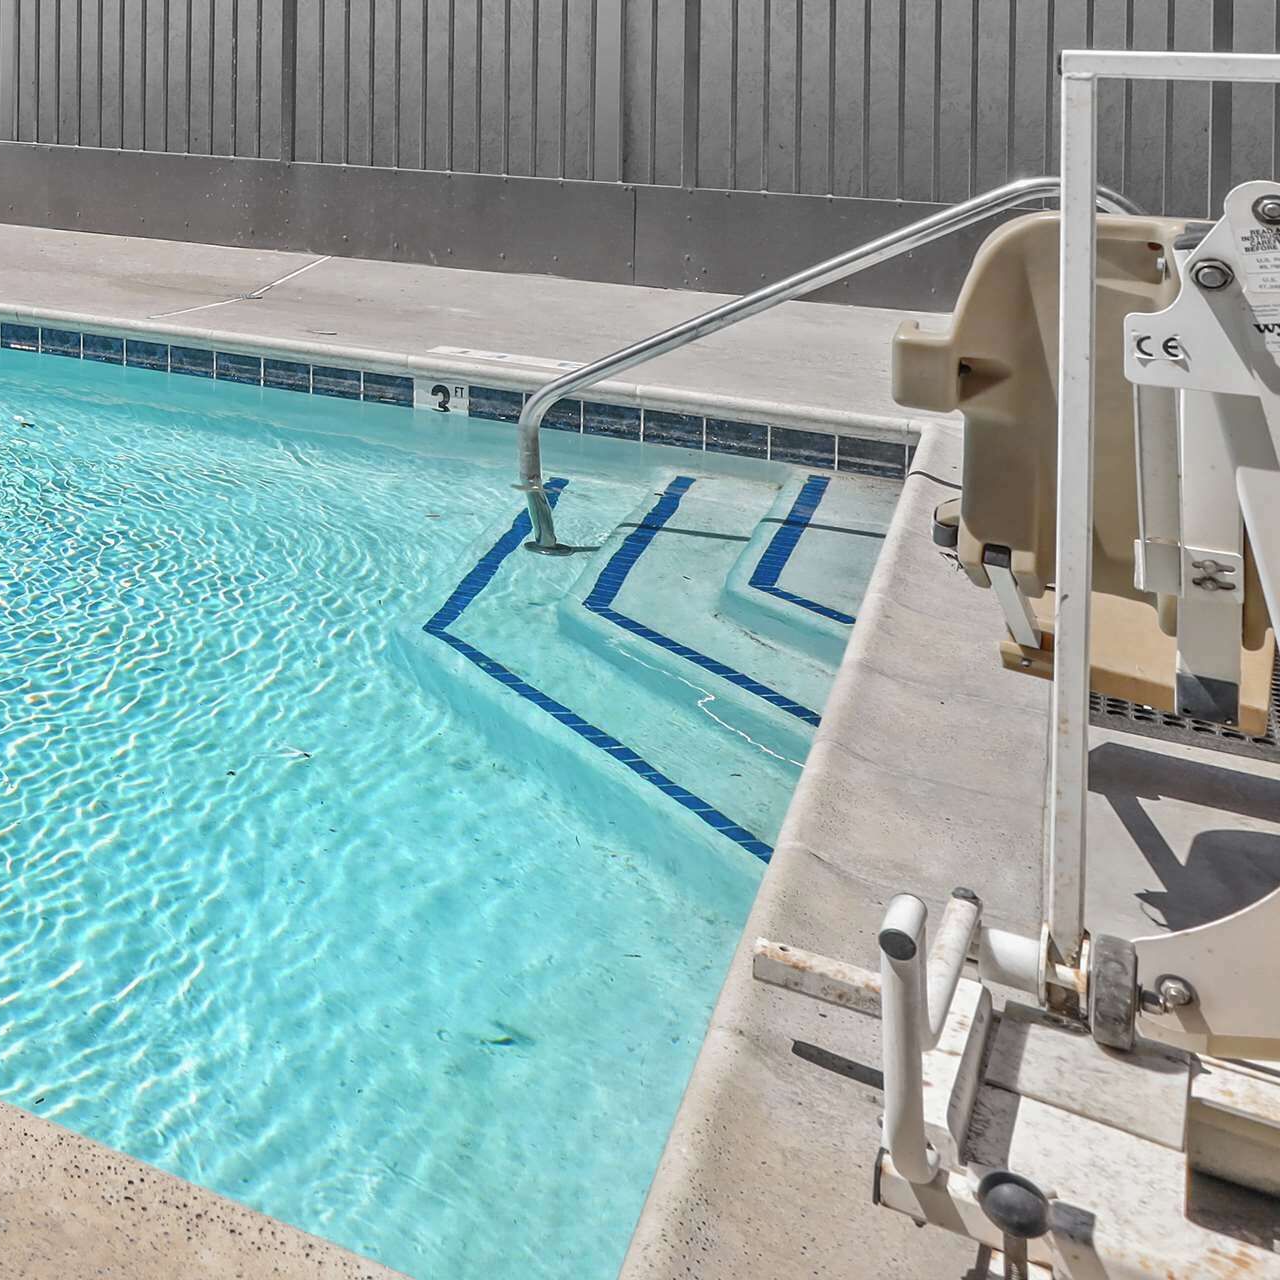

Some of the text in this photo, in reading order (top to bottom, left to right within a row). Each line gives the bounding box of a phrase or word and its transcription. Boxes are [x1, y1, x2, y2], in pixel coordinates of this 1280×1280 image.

[1244, 244, 1278, 252] BEFORE
[1136, 335, 1179, 358] CE
[454, 386, 465, 398] FT
